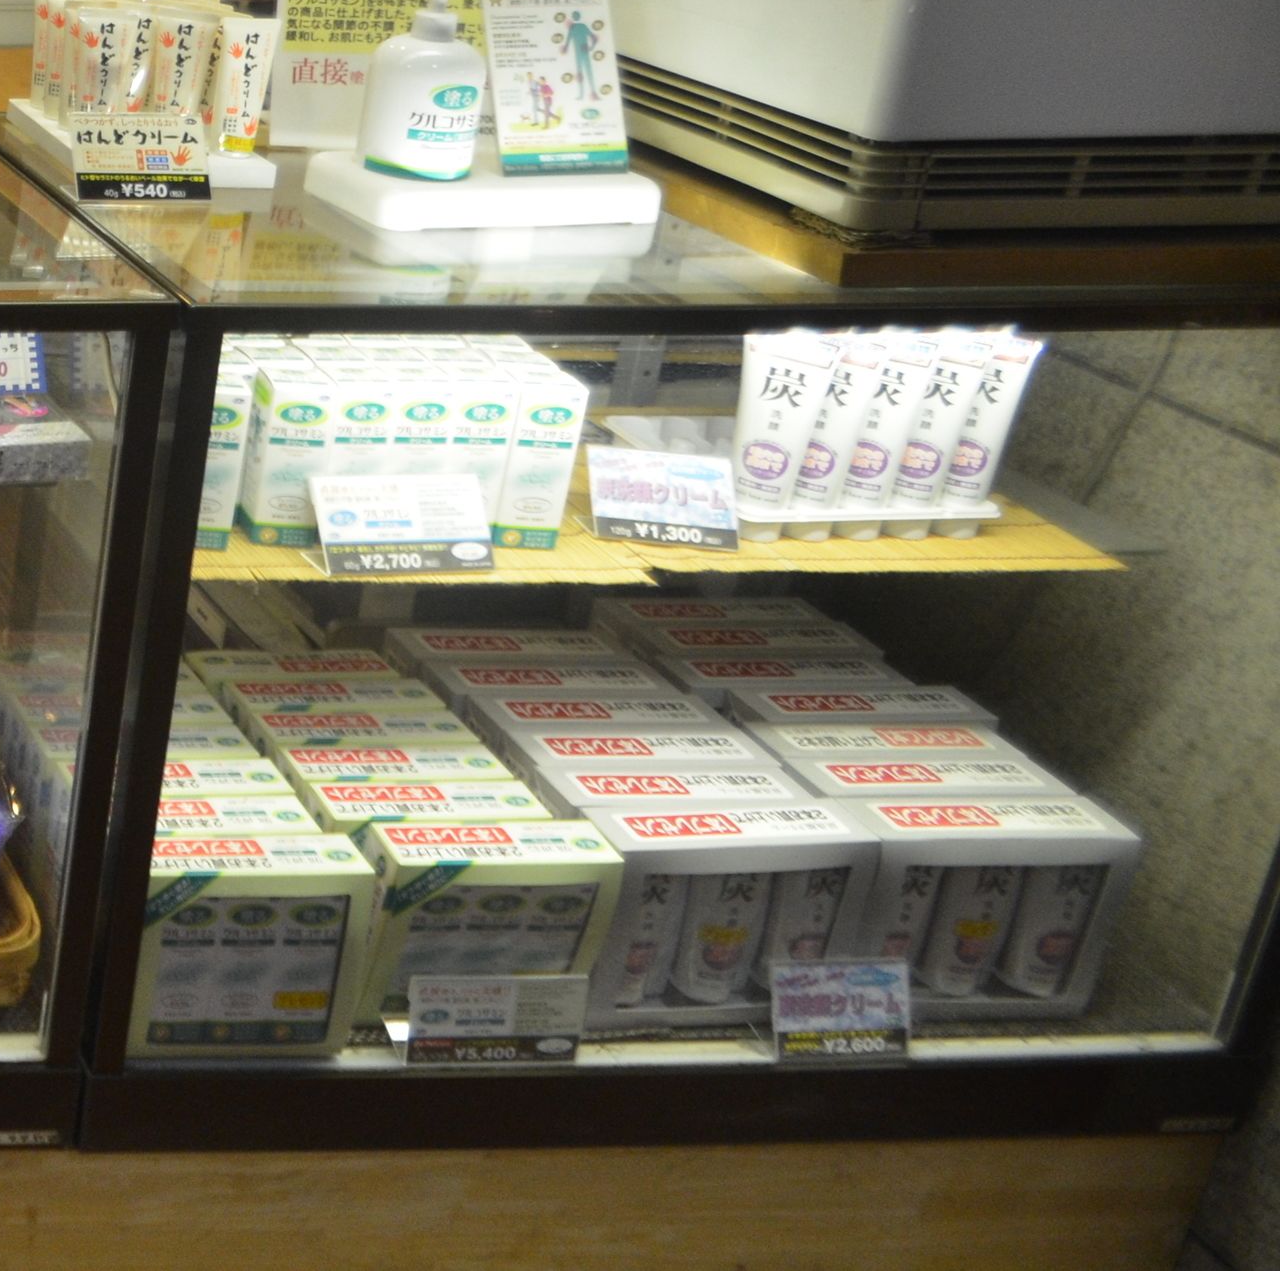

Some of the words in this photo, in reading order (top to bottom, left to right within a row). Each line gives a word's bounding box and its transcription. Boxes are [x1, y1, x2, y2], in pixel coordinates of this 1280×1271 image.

[288, 7, 413, 18] の商品に仕上げました。
[97, 23, 116, 107] はんどクリーム
[170, 24, 194, 107] はんどクリーム
[242, 33, 260, 118] はんどクリーム
[444, 89, 472, 107] 塗る
[77, 129, 198, 144] はんどクリーム
[104, 189, 119, 198] 40g
[121, 183, 168, 198] ¥540
[760, 366, 807, 409] 炭
[634, 522, 702, 544] ¥1,300
[360, 553, 423, 571] ¥2,700
[454, 1046, 516, 1061] ¥5,400
[823, 1036, 886, 1055] ¥2,600
